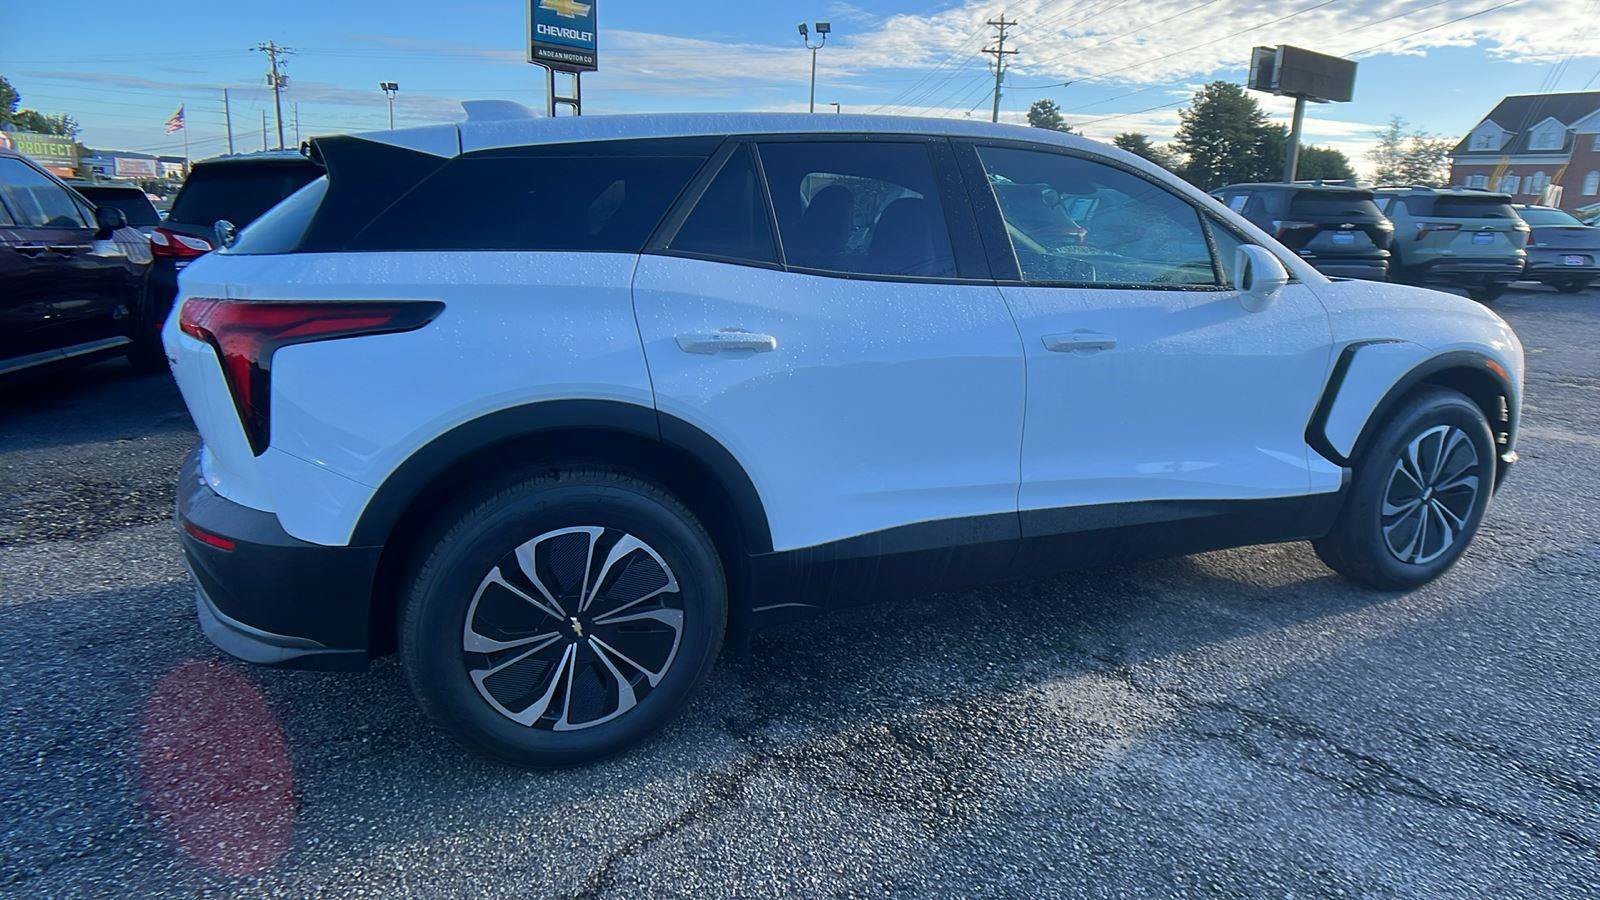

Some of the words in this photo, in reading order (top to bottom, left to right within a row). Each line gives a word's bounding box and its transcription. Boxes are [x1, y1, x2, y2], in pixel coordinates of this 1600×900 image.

[537, 24, 593, 41] CHEVROLET
[563, 53, 583, 62] MOTOR
[17, 141, 72, 156] PROTECT
